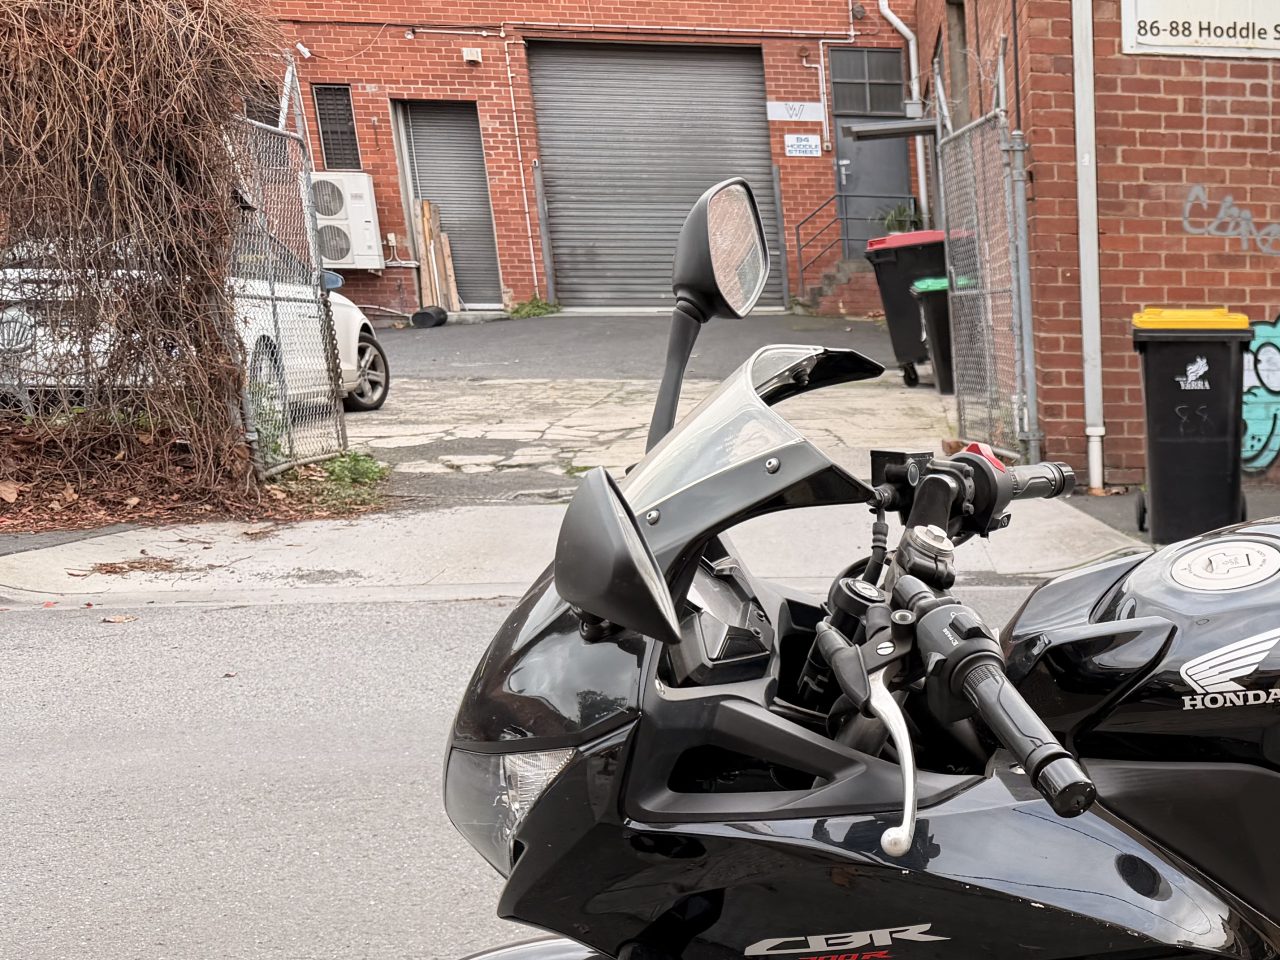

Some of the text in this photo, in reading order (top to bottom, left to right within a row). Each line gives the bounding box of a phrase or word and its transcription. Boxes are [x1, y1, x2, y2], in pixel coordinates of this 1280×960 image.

[1136, 20, 1192, 37] 86-88
[1199, 21, 1267, 41] Hoddle
[744, 922, 951, 956] CBR
